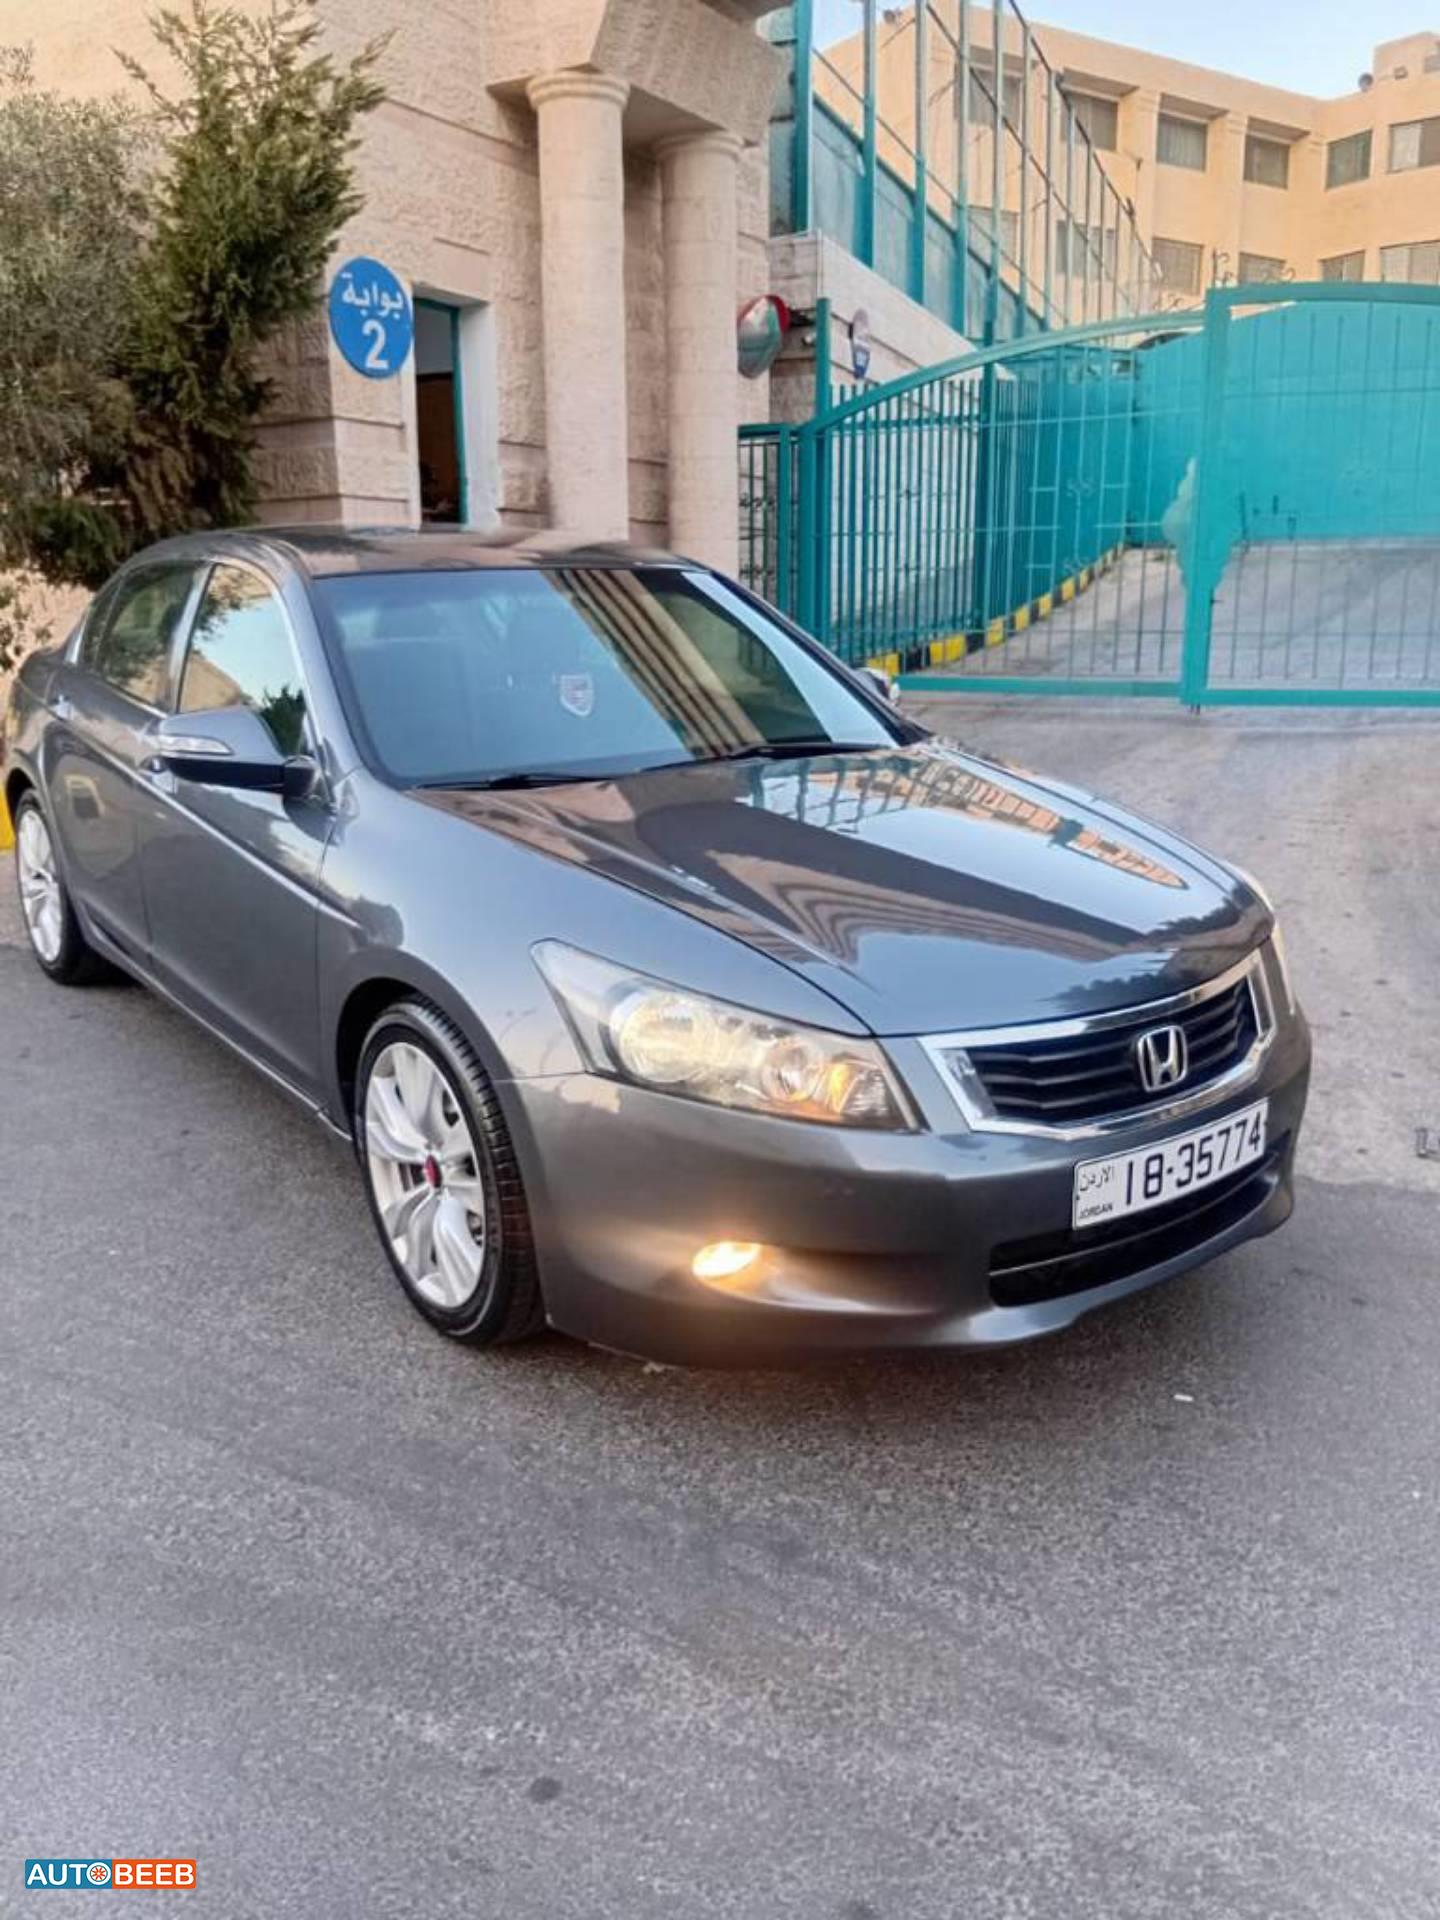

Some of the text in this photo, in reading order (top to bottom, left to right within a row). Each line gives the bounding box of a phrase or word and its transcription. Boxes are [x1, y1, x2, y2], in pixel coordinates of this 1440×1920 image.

[341, 272, 404, 319] بوابة
[362, 319, 389, 369] 2
[1124, 1111, 1261, 1205] 18-35774
[1079, 1203, 1113, 1219] JORDAN
